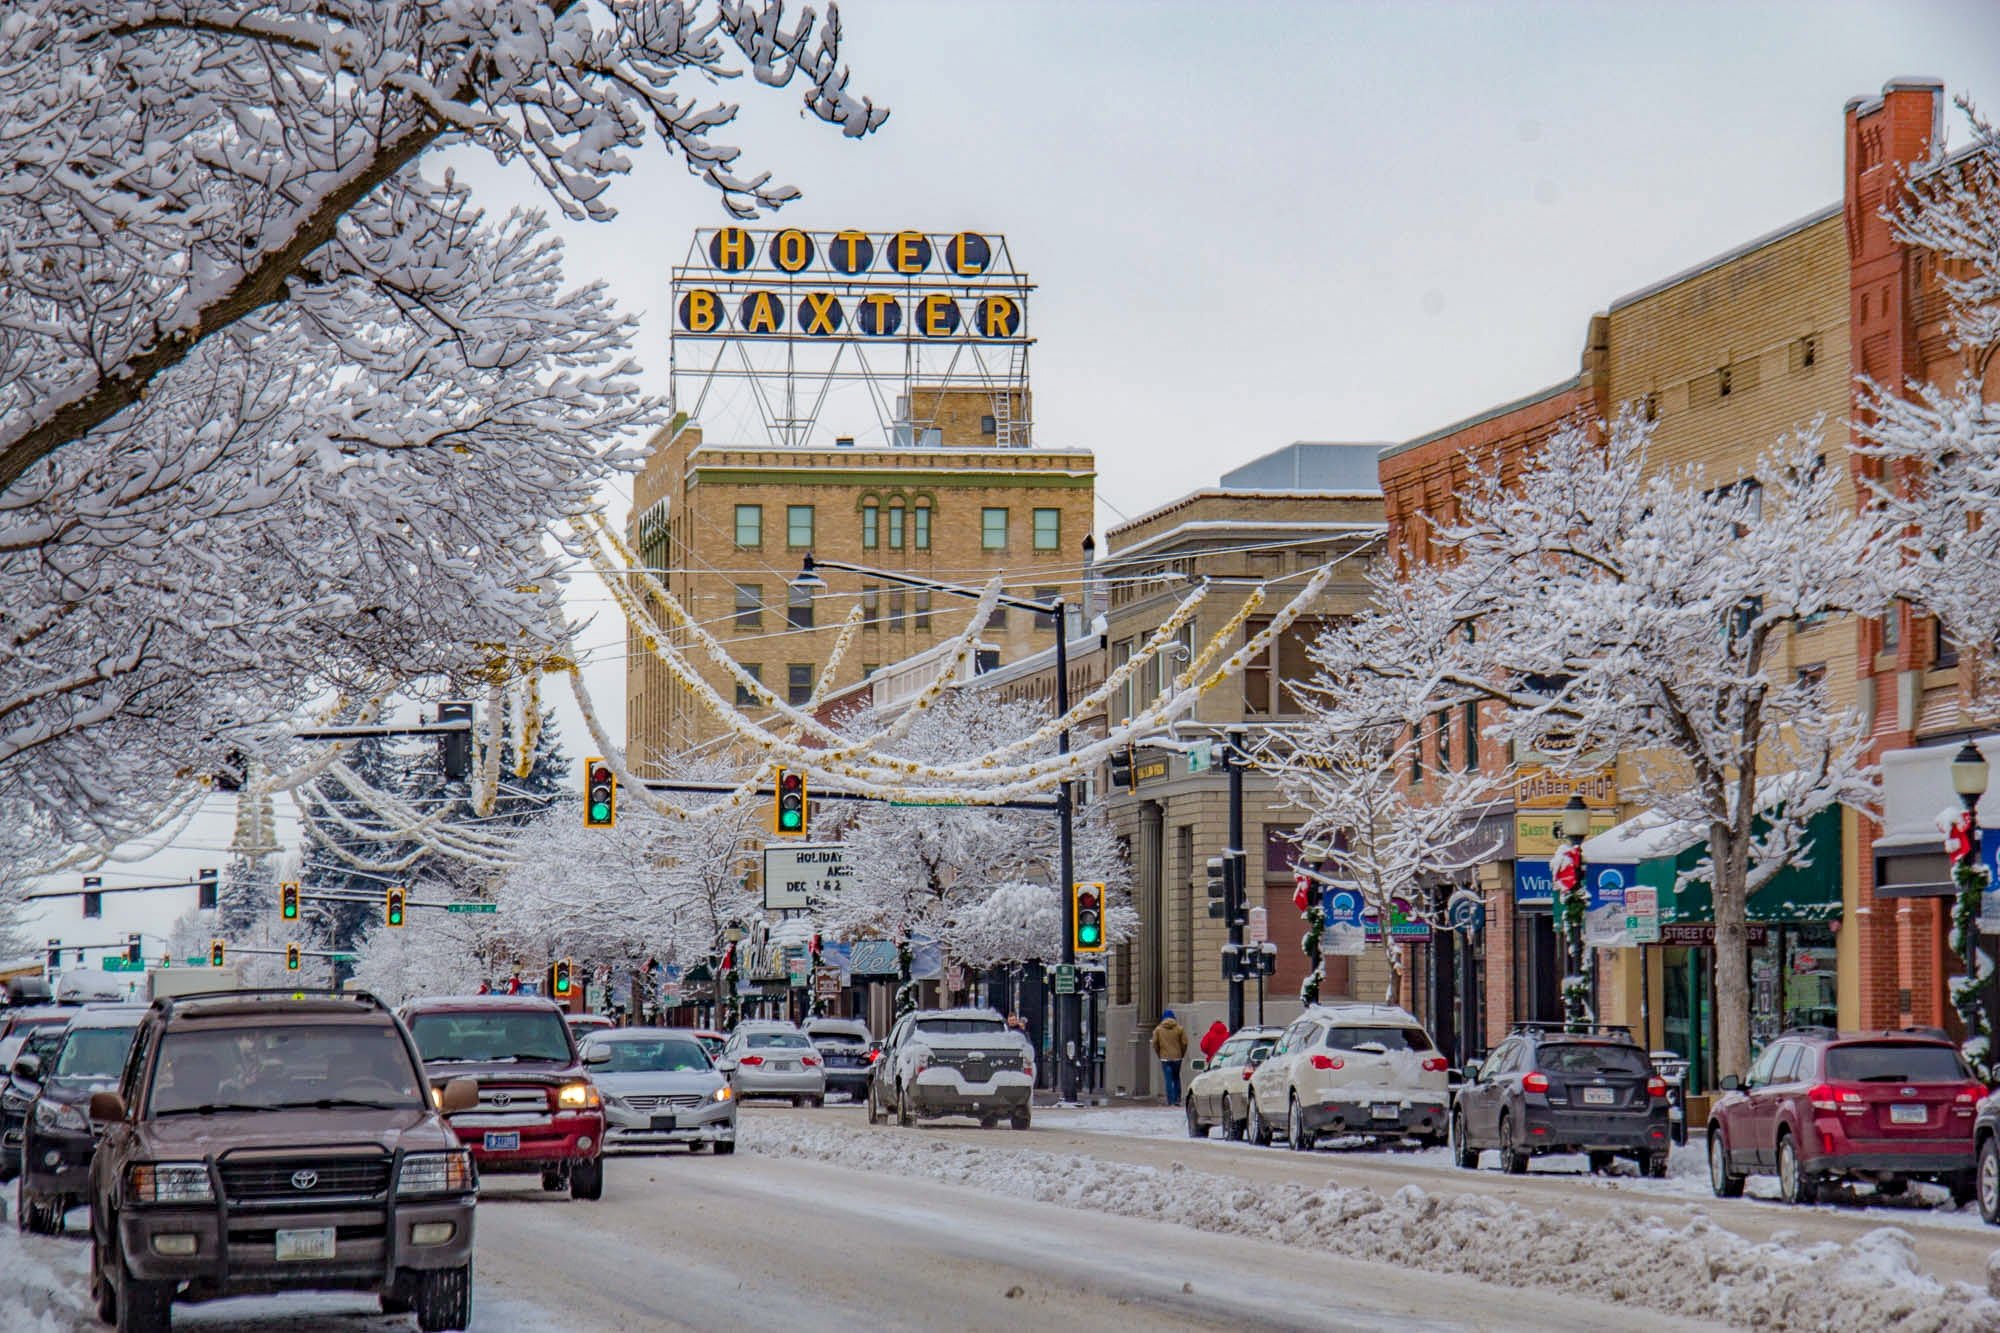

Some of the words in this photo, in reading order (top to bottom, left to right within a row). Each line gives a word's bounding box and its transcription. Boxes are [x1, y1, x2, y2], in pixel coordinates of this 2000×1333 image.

[720, 228, 981, 274] HOTEL
[689, 290, 1011, 337] BAXTER
[1520, 776, 1569, 802] BARBER
[1577, 775, 1613, 800] SHOP
[796, 852, 842, 863] HOLIDAY
[786, 881, 807, 892] DEC
[834, 880, 842, 891] 2
[1521, 875, 1551, 890] Win
[1663, 926, 1705, 941] STREET
